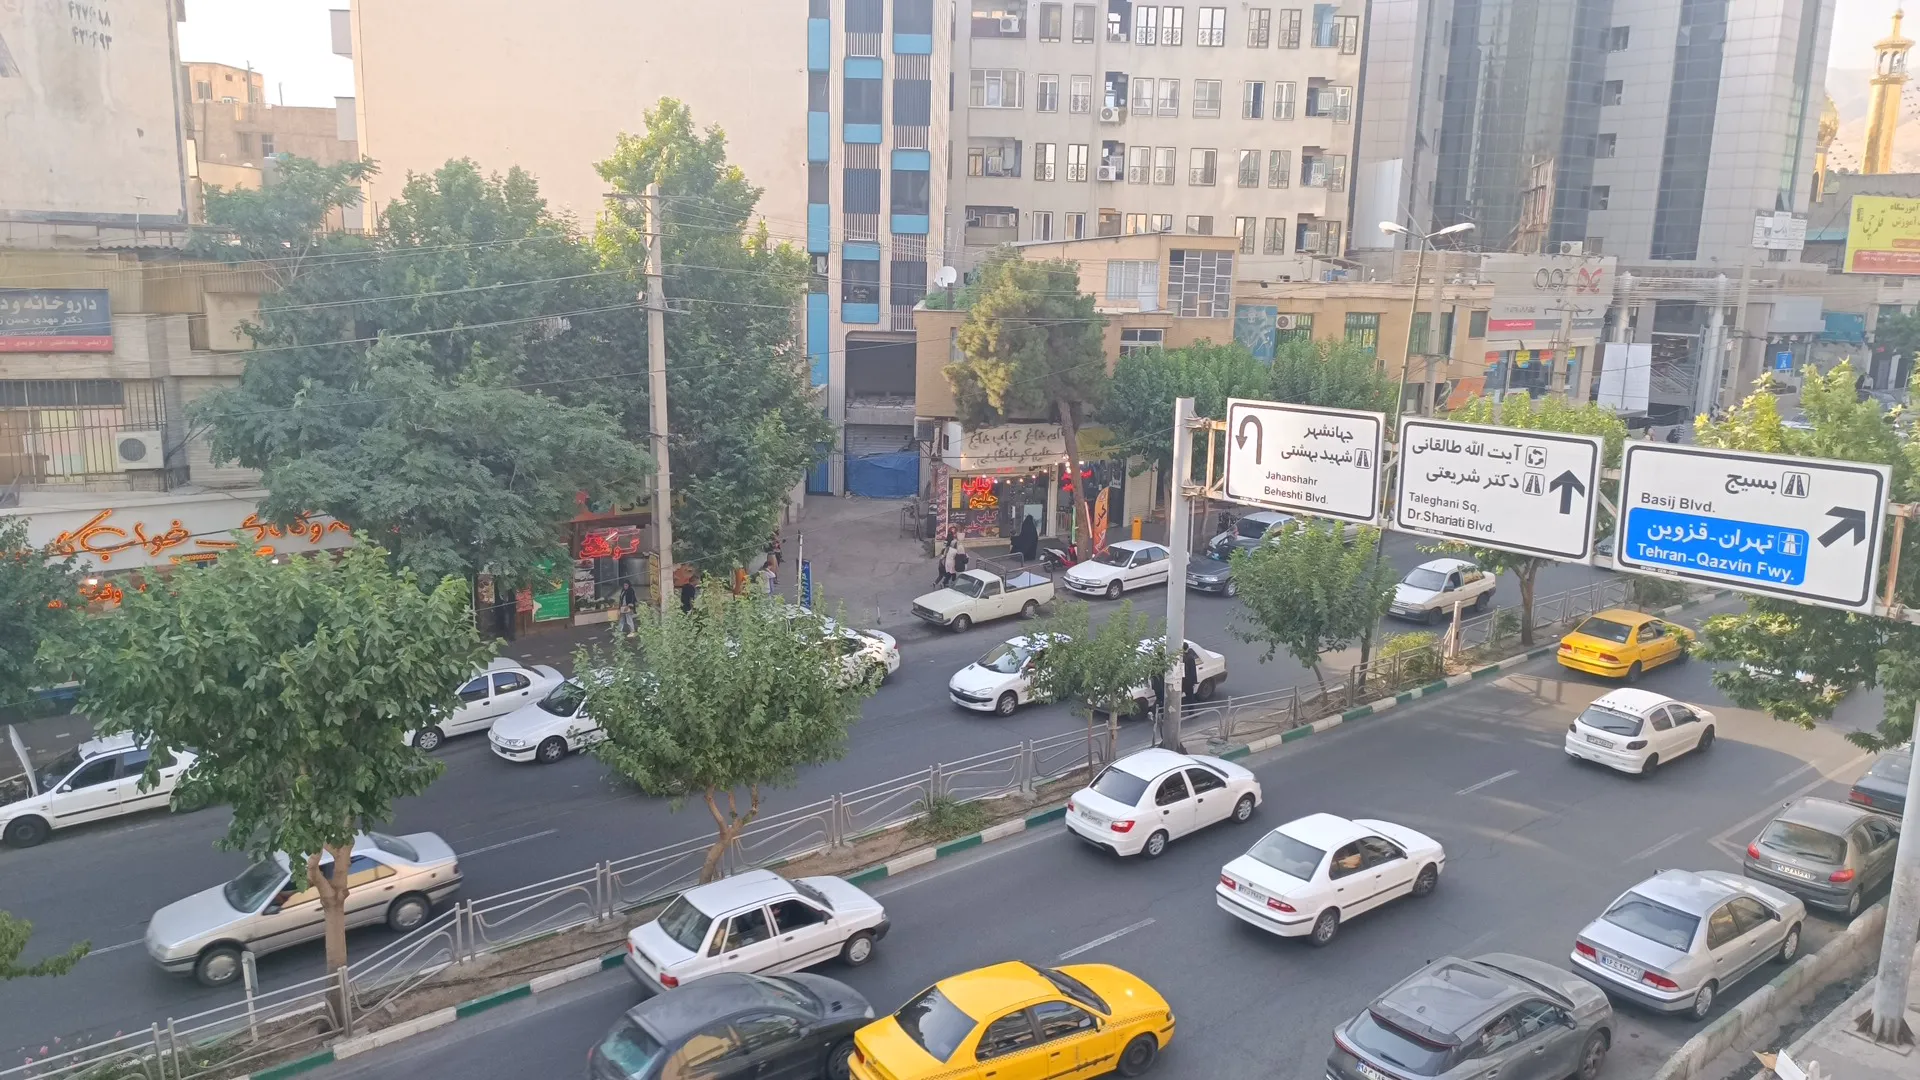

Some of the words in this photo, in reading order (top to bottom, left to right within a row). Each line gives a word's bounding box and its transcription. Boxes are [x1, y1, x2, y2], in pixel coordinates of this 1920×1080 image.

[23, 295, 97, 314] داروخانه
[61, 315, 83, 326] دکتر
[1304, 424, 1354, 443] جهانشهر
[1281, 444, 1318, 462] بهشتی
[1412, 437, 1462, 454] طالقانی
[1464, 440, 1484, 457] الله
[1487, 443, 1523, 465] آیت
[1319, 450, 1353, 466] شهید
[1265, 471, 1318, 486] Jahanshahr
[1426, 466, 1480, 485] شریعتی
[1482, 473, 1519, 490] دکتر
[1724, 473, 1777, 495] بسیج
[962, 476, 993, 496] کباب
[1264, 486, 1303, 500] Beheshti
[1305, 493, 1329, 505] Blvd.
[1408, 491, 1459, 510] Taleghani
[1462, 500, 1480, 513] Sq.
[1640, 492, 1676, 510] Basij
[1679, 497, 1716, 513] Blvd.
[1467, 519, 1496, 534] Blvd.
[1637, 543, 1752, 573] Tehran-Qazvin
[1756, 562, 1795, 583] Fwy.
